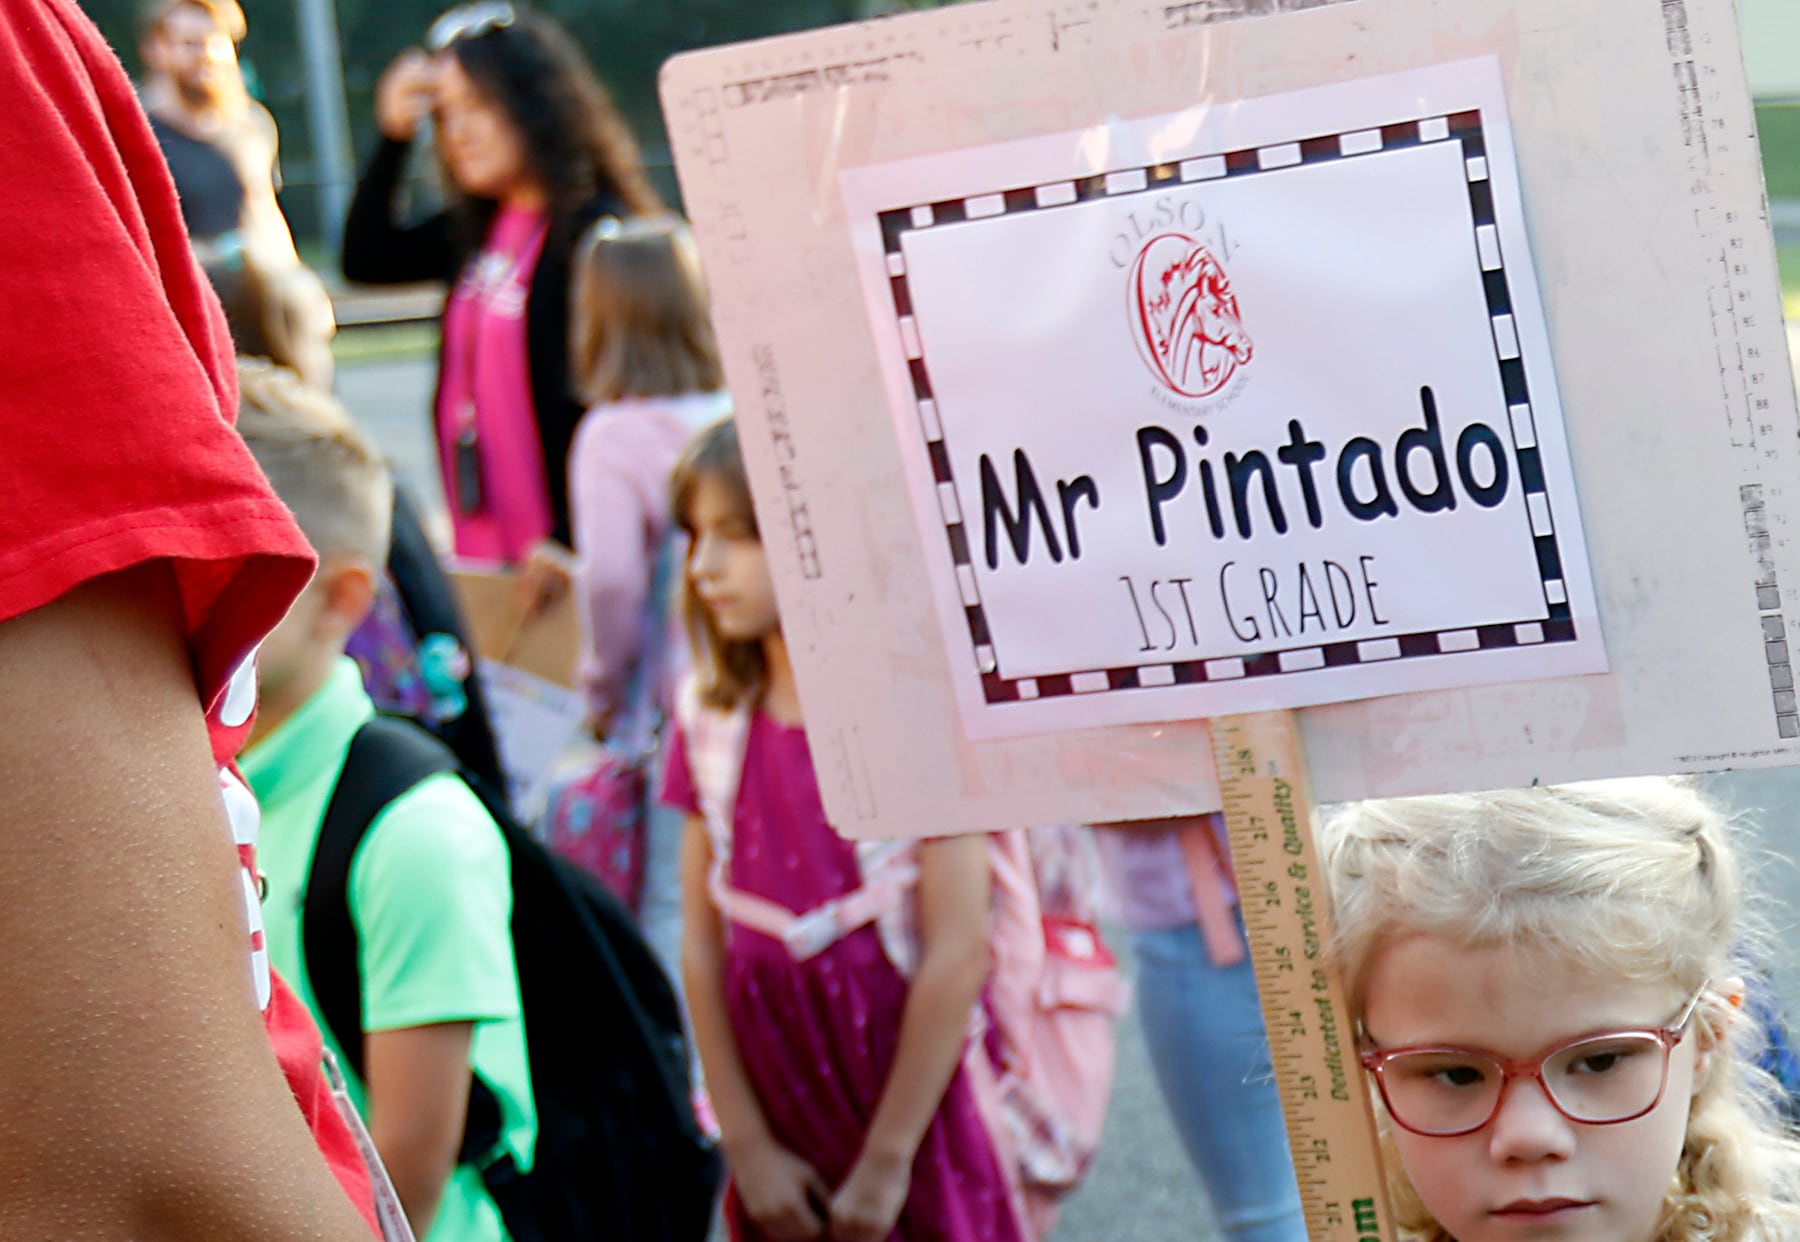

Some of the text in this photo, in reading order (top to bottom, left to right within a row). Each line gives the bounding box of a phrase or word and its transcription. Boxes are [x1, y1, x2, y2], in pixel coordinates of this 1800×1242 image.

[1108, 197, 1241, 269] OLSON
[979, 385, 1510, 571] Mr Pintado
[1250, 816, 1267, 839] 27
[1266, 881, 1279, 904] 26
[1295, 886, 1321, 960] Service
[1276, 947, 1292, 970] 25
[1310, 968, 1328, 991] to
[1289, 1012, 1305, 1034] 24
[1314, 998, 1349, 1101] Dedicated
[1301, 1076, 1317, 1098] 23
[1313, 1140, 1329, 1160] 22
[1325, 1202, 1341, 1223] 21
